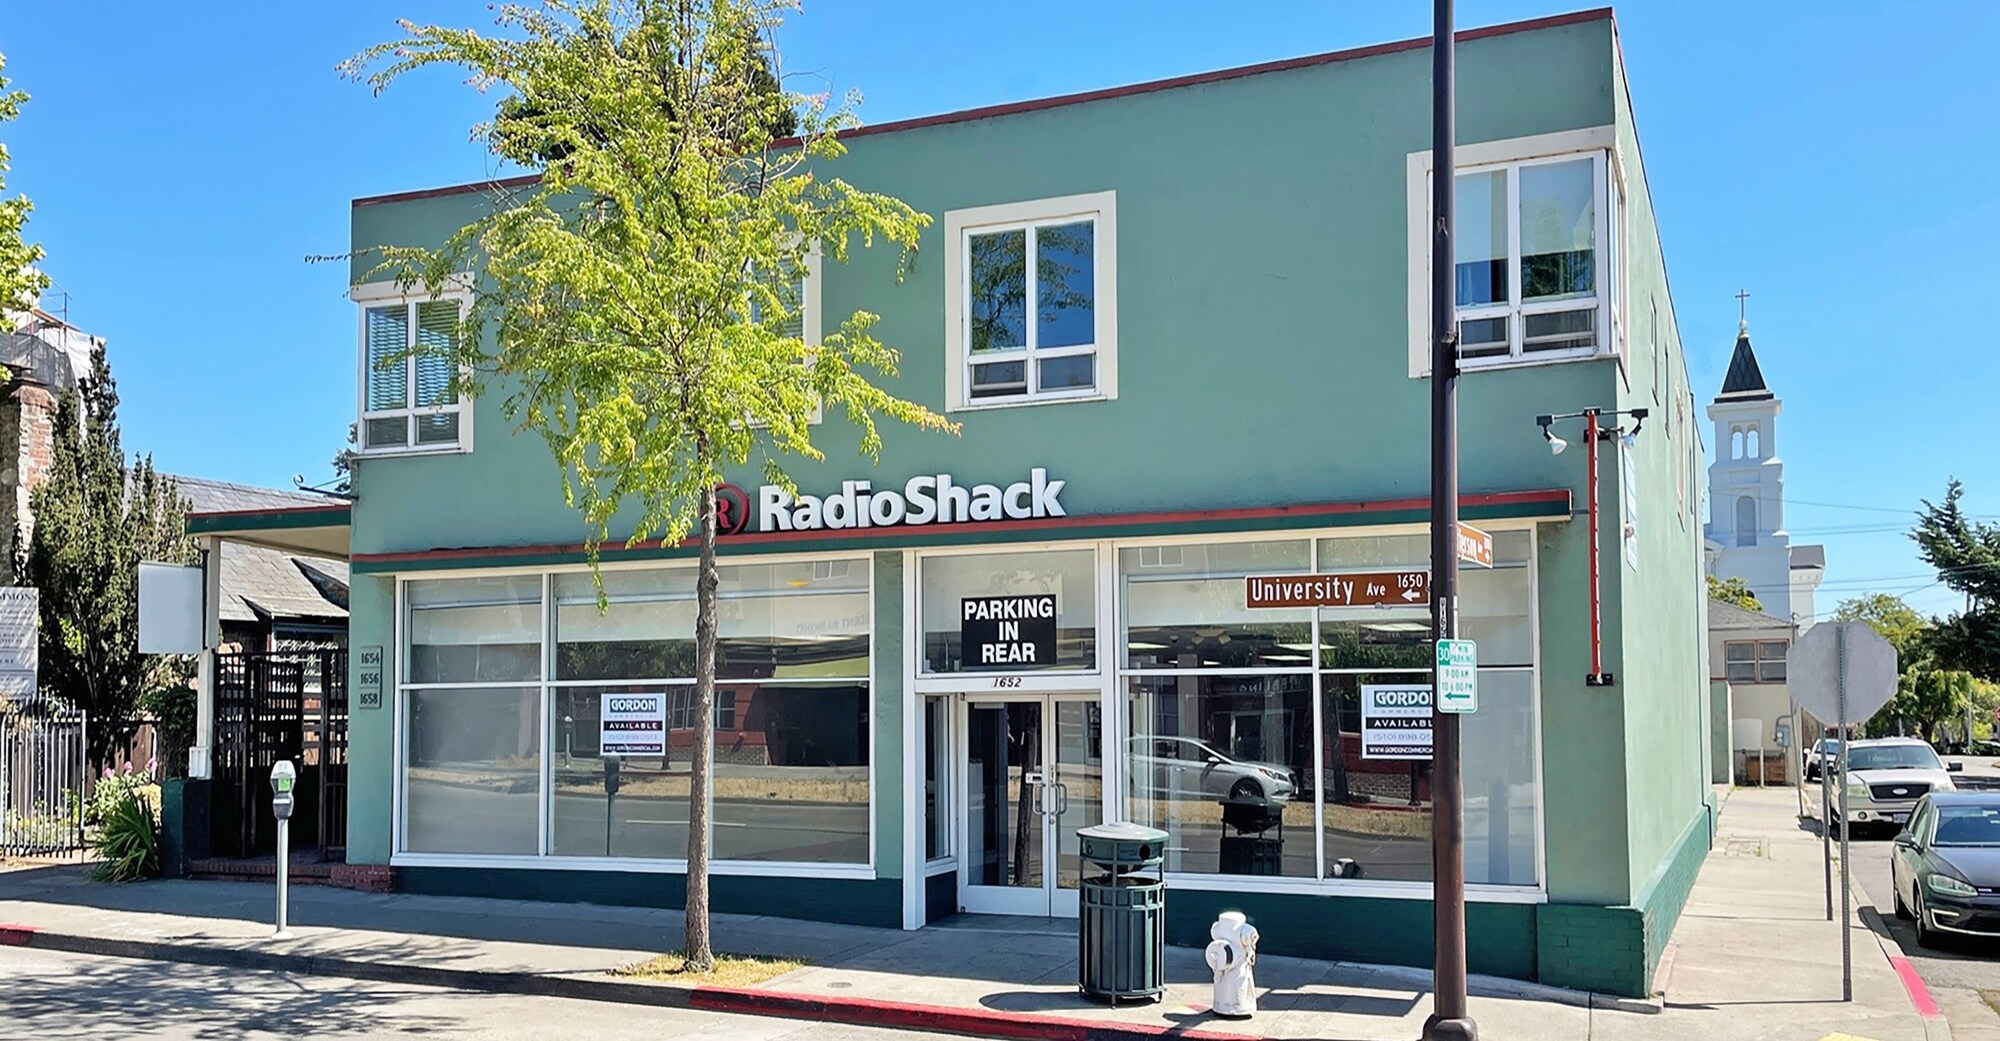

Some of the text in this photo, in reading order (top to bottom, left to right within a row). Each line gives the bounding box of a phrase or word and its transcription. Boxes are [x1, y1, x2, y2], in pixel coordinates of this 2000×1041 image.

[759, 467, 1068, 533] RadioShack
[1251, 574, 1423, 605] University Ave 1650
[964, 597, 1054, 620] PARKING
[998, 621, 1019, 641] IN
[361, 652, 380, 664] 1654
[982, 642, 1036, 663] REAR
[1438, 646, 1450, 662] 30
[360, 672, 379, 684] 1656
[993, 677, 1022, 688] 1652
[1442, 682, 1449, 691] TO
[1464, 682, 1473, 691] PM
[360, 692, 379, 704] 1658
[611, 699, 656, 711] GORDON
[1373, 719, 1433, 727] AVAILABL
